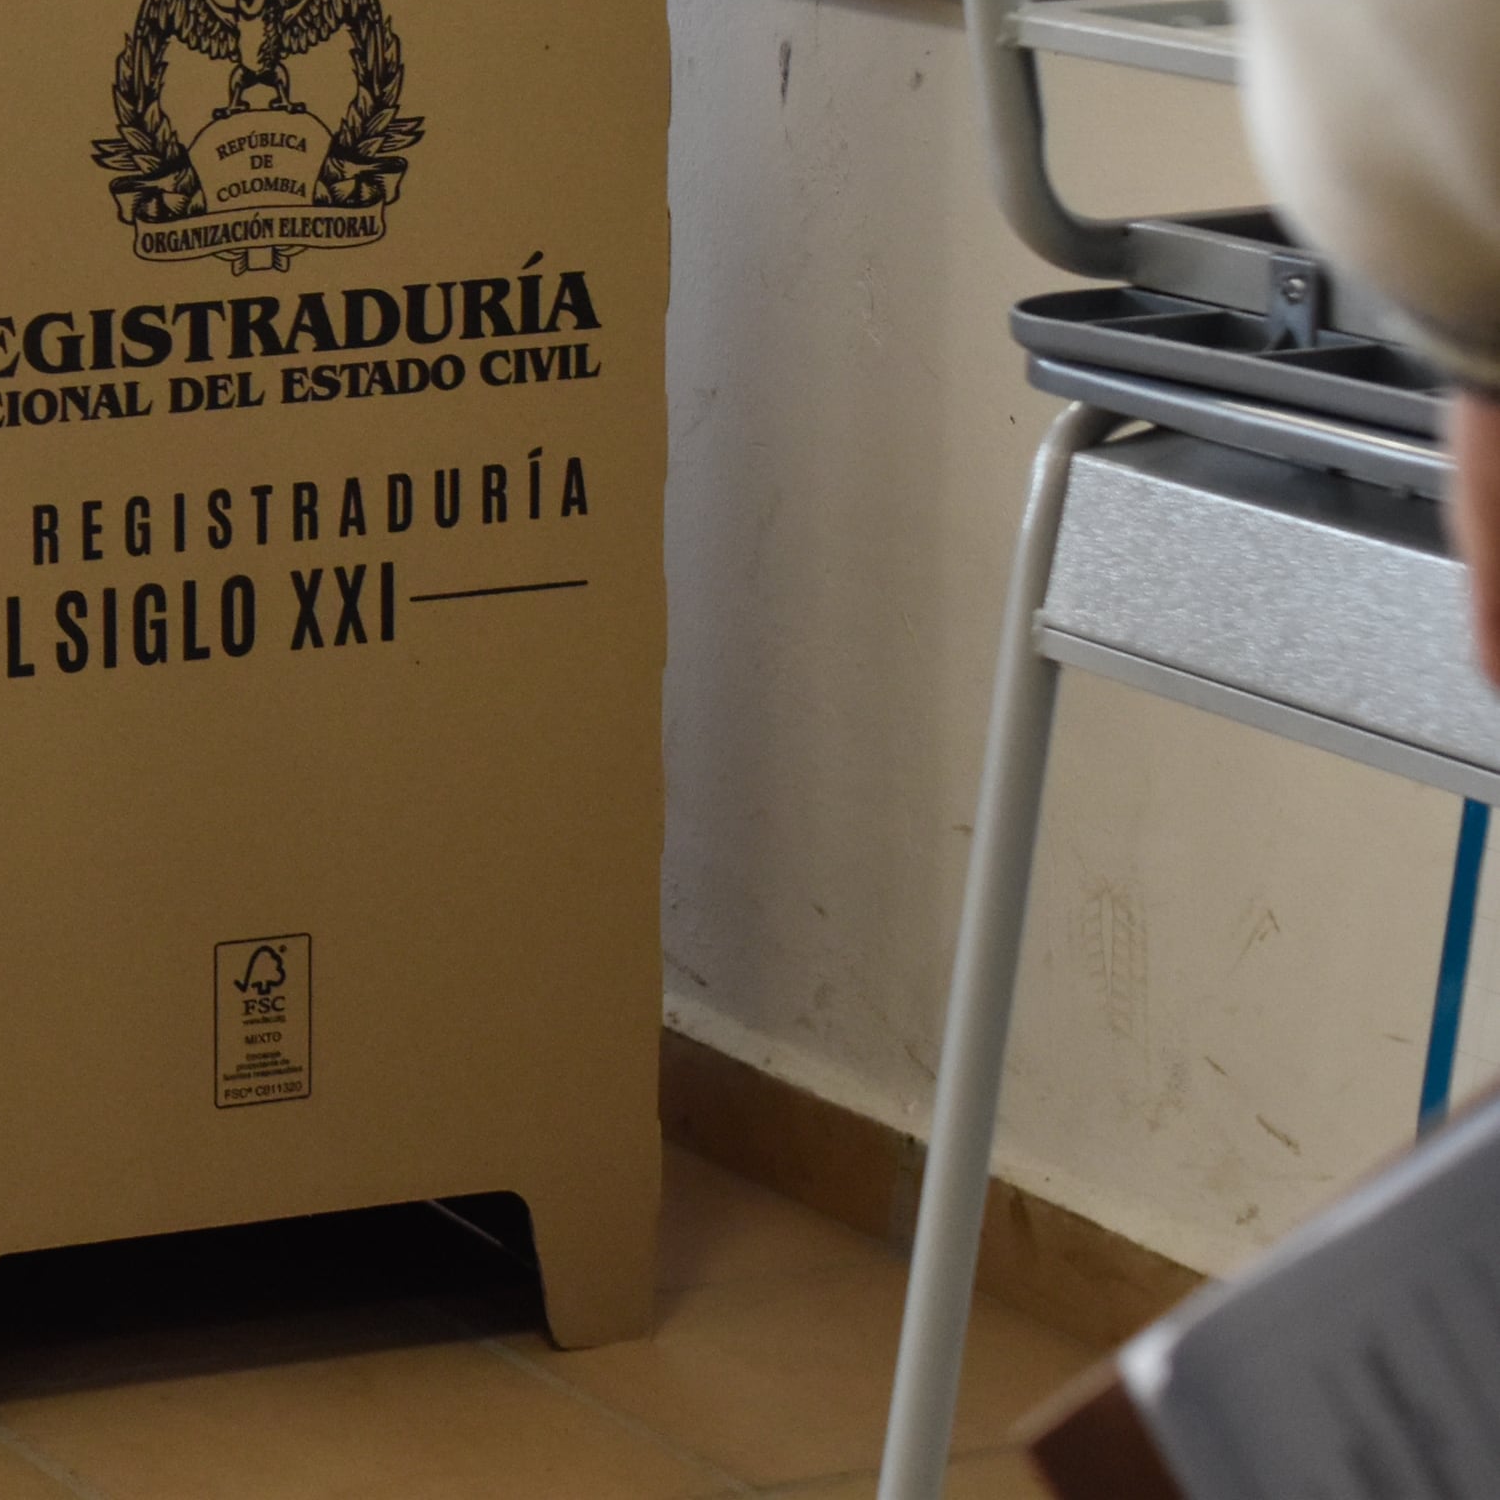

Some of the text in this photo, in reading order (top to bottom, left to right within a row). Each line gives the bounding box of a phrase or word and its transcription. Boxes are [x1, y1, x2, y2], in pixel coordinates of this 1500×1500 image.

[216, 131, 308, 160] REPÚBLICA
[250, 154, 274, 170] DE
[216, 177, 307, 203] COLOMBIA
[142, 212, 379, 253] ORGANIZACIÓN ELECTORAL
[168, 372, 266, 414] DEL
[281, 352, 466, 405] ESTADO
[479, 343, 602, 387] CIVIL
[32, 446, 589, 567] REGISTRADURÍA
[55, 573, 256, 674] SIGLO
[289, 561, 396, 651] XXI
[241, 996, 286, 1015] FSC
[244, 1031, 282, 1044] MIXTO
